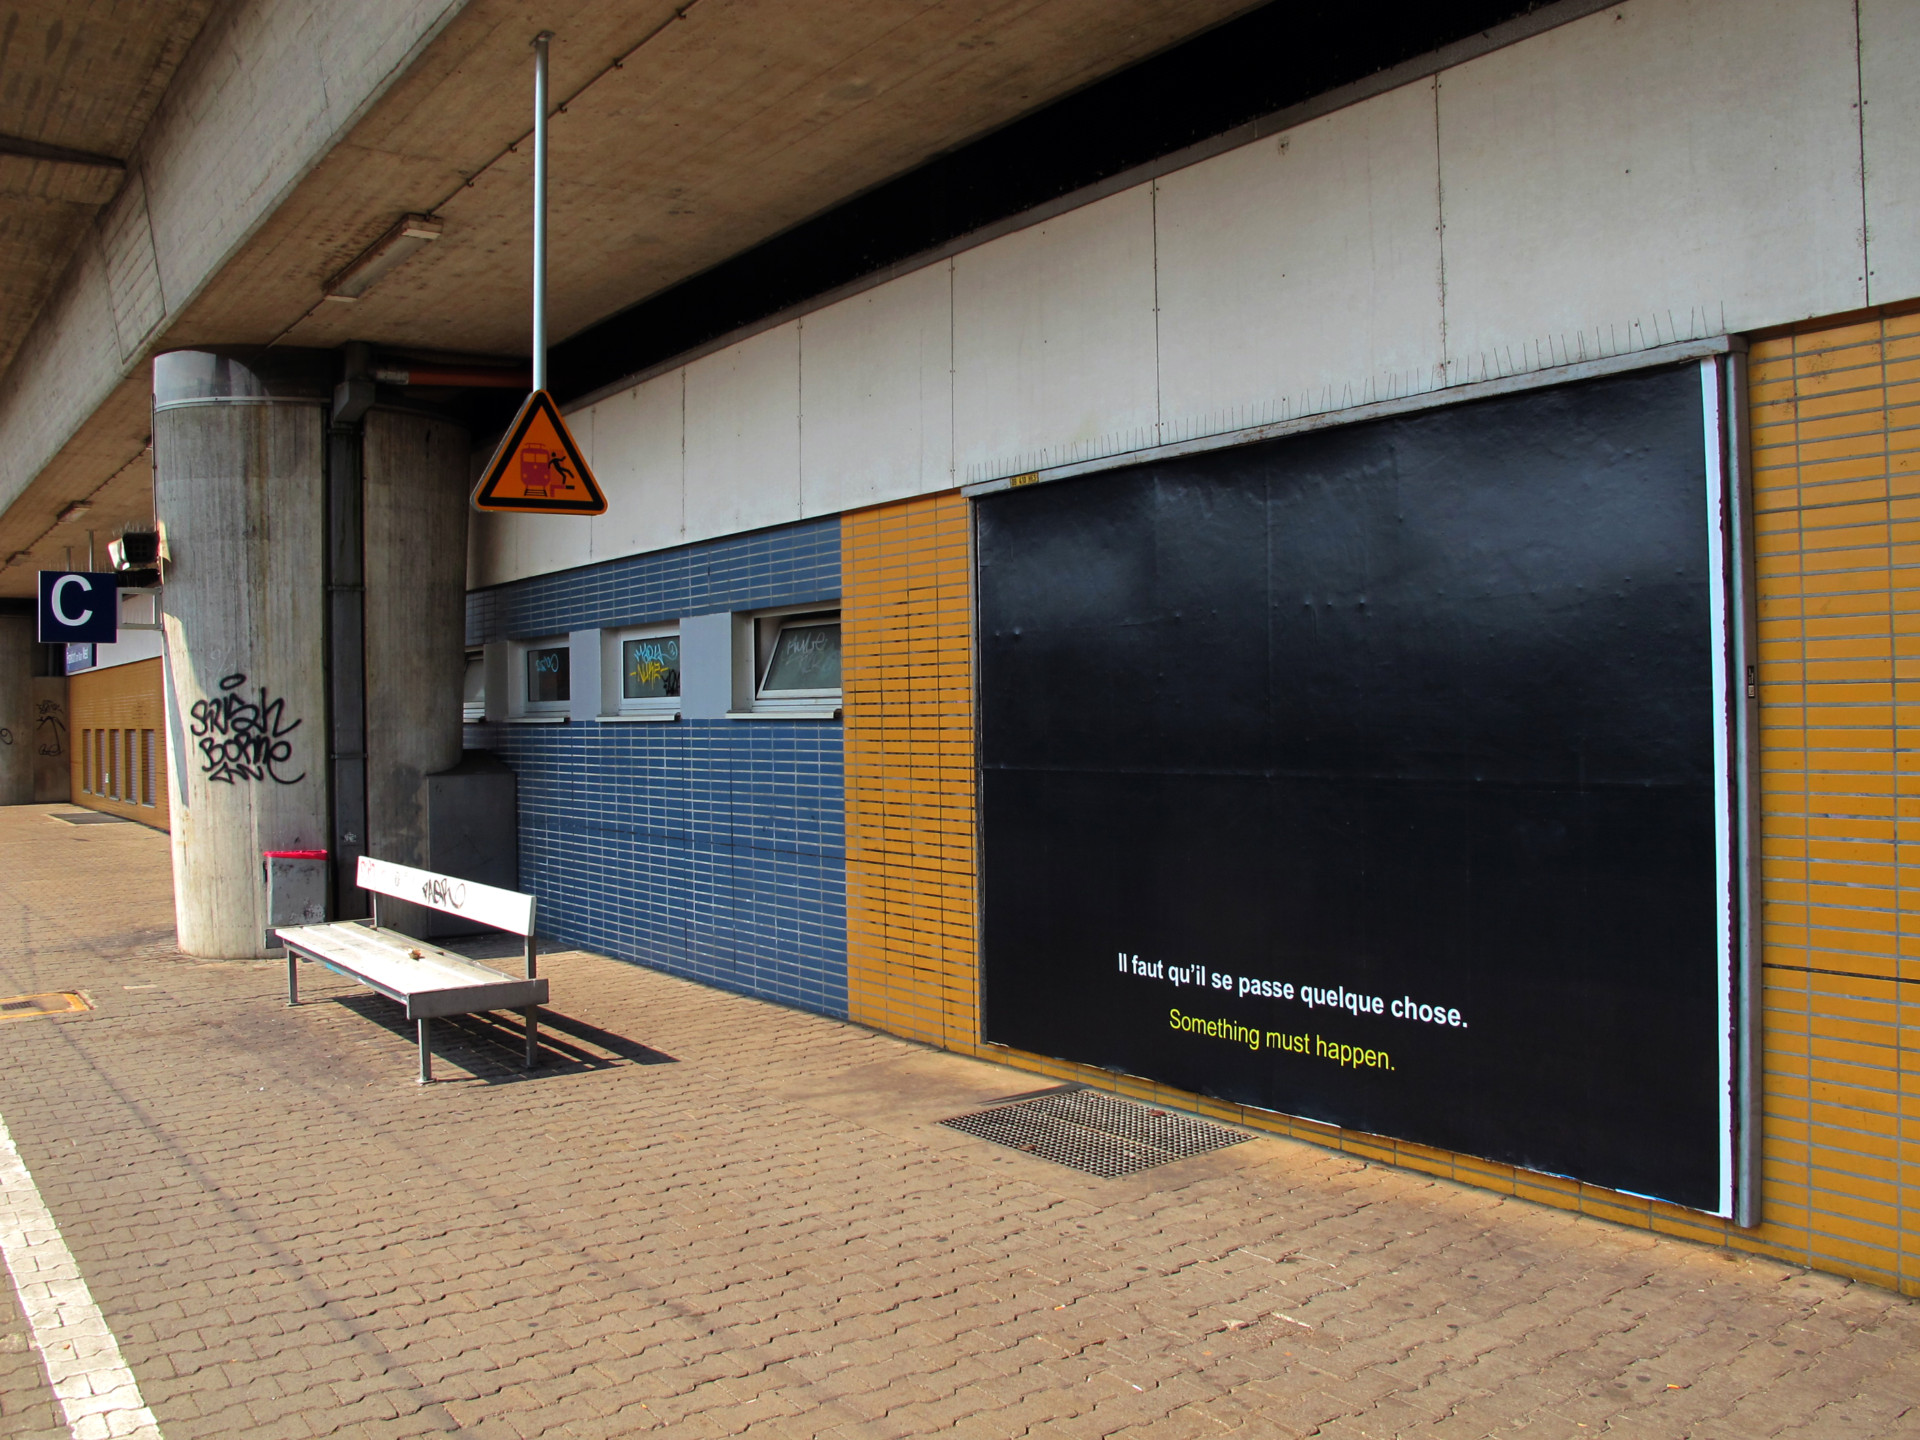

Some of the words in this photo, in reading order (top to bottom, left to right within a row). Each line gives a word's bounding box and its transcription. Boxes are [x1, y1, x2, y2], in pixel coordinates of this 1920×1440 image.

[51, 574, 93, 627] C
[1118, 952, 1128, 973] Il
[1131, 955, 1164, 980] faut
[1167, 963, 1206, 988] qu'il
[1210, 972, 1233, 991] se
[1238, 977, 1295, 1000] passe
[1300, 986, 1385, 1017] quelque
[1390, 995, 1468, 1029] chose.
[1169, 1008, 1260, 1051] Something
[1266, 1032, 1311, 1055] must
[1316, 1033, 1395, 1071] happen.
